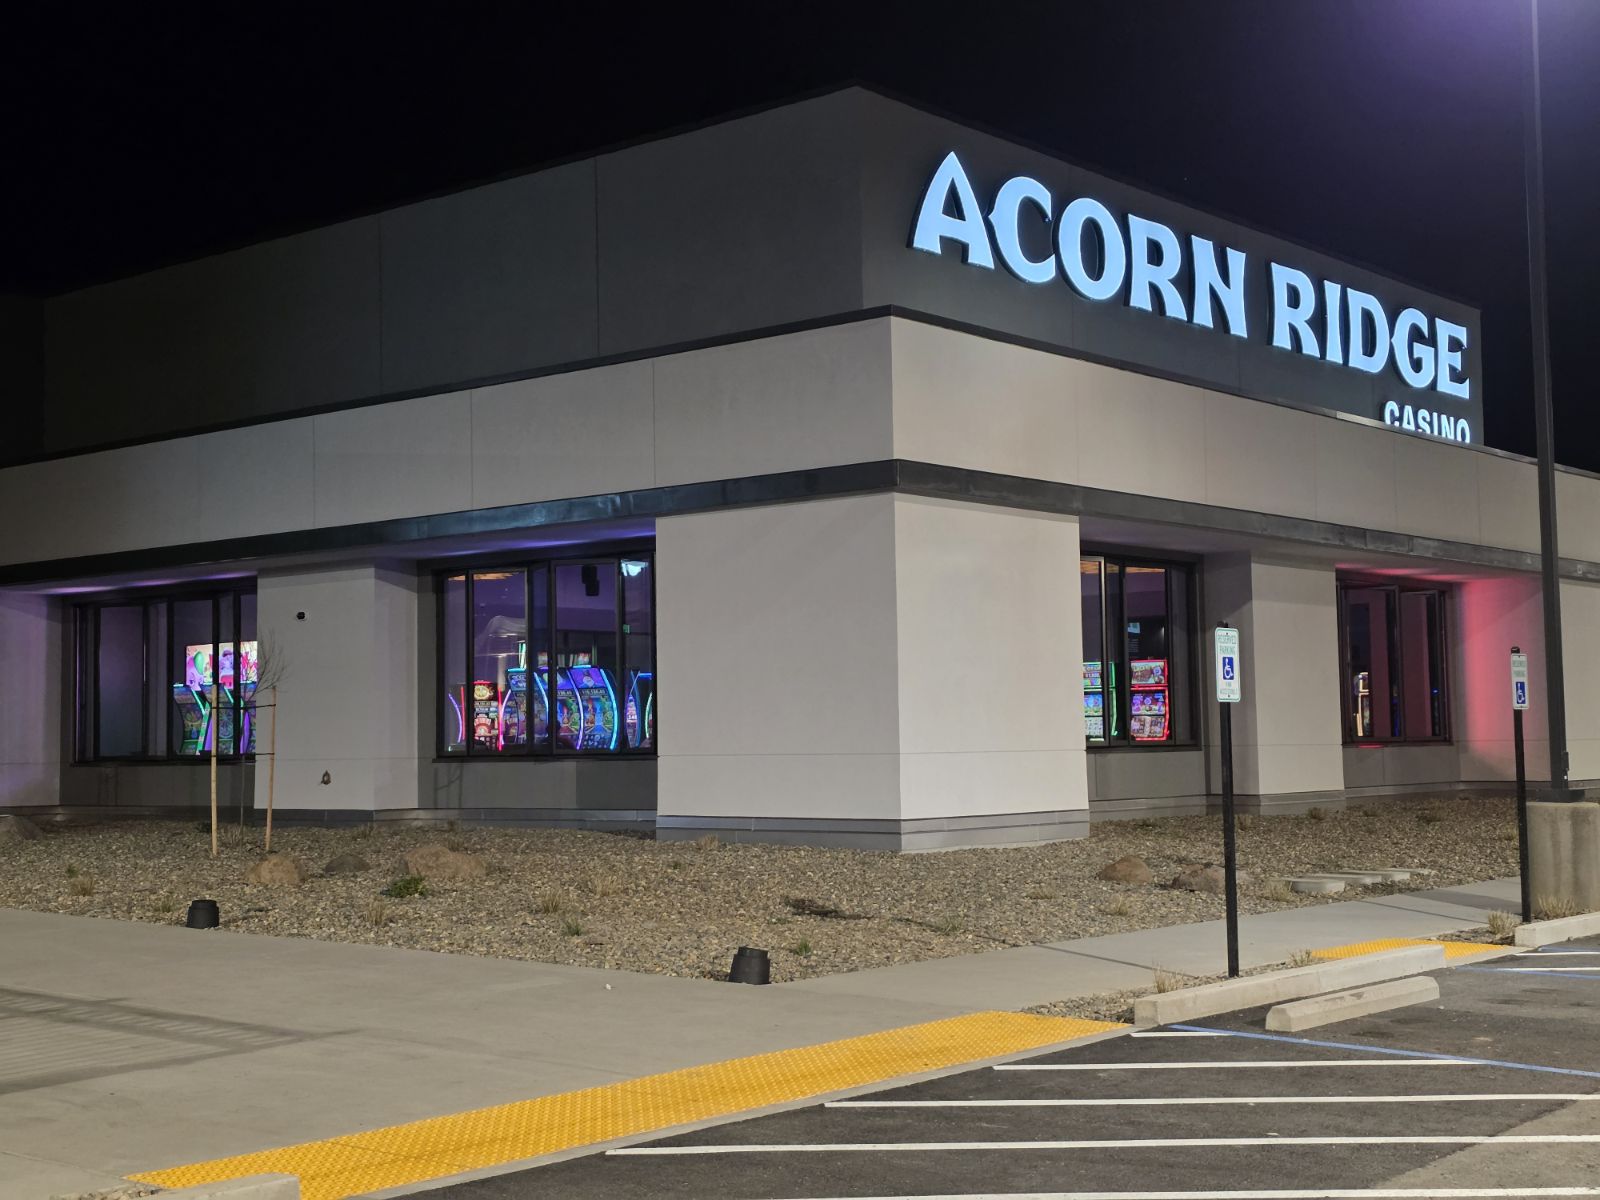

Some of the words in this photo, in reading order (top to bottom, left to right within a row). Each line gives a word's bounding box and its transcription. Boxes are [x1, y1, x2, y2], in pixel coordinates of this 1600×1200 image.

[913, 151, 1248, 338] ACORN
[1270, 261, 1470, 400] RIDGE
[1384, 400, 1471, 444] CASINO
